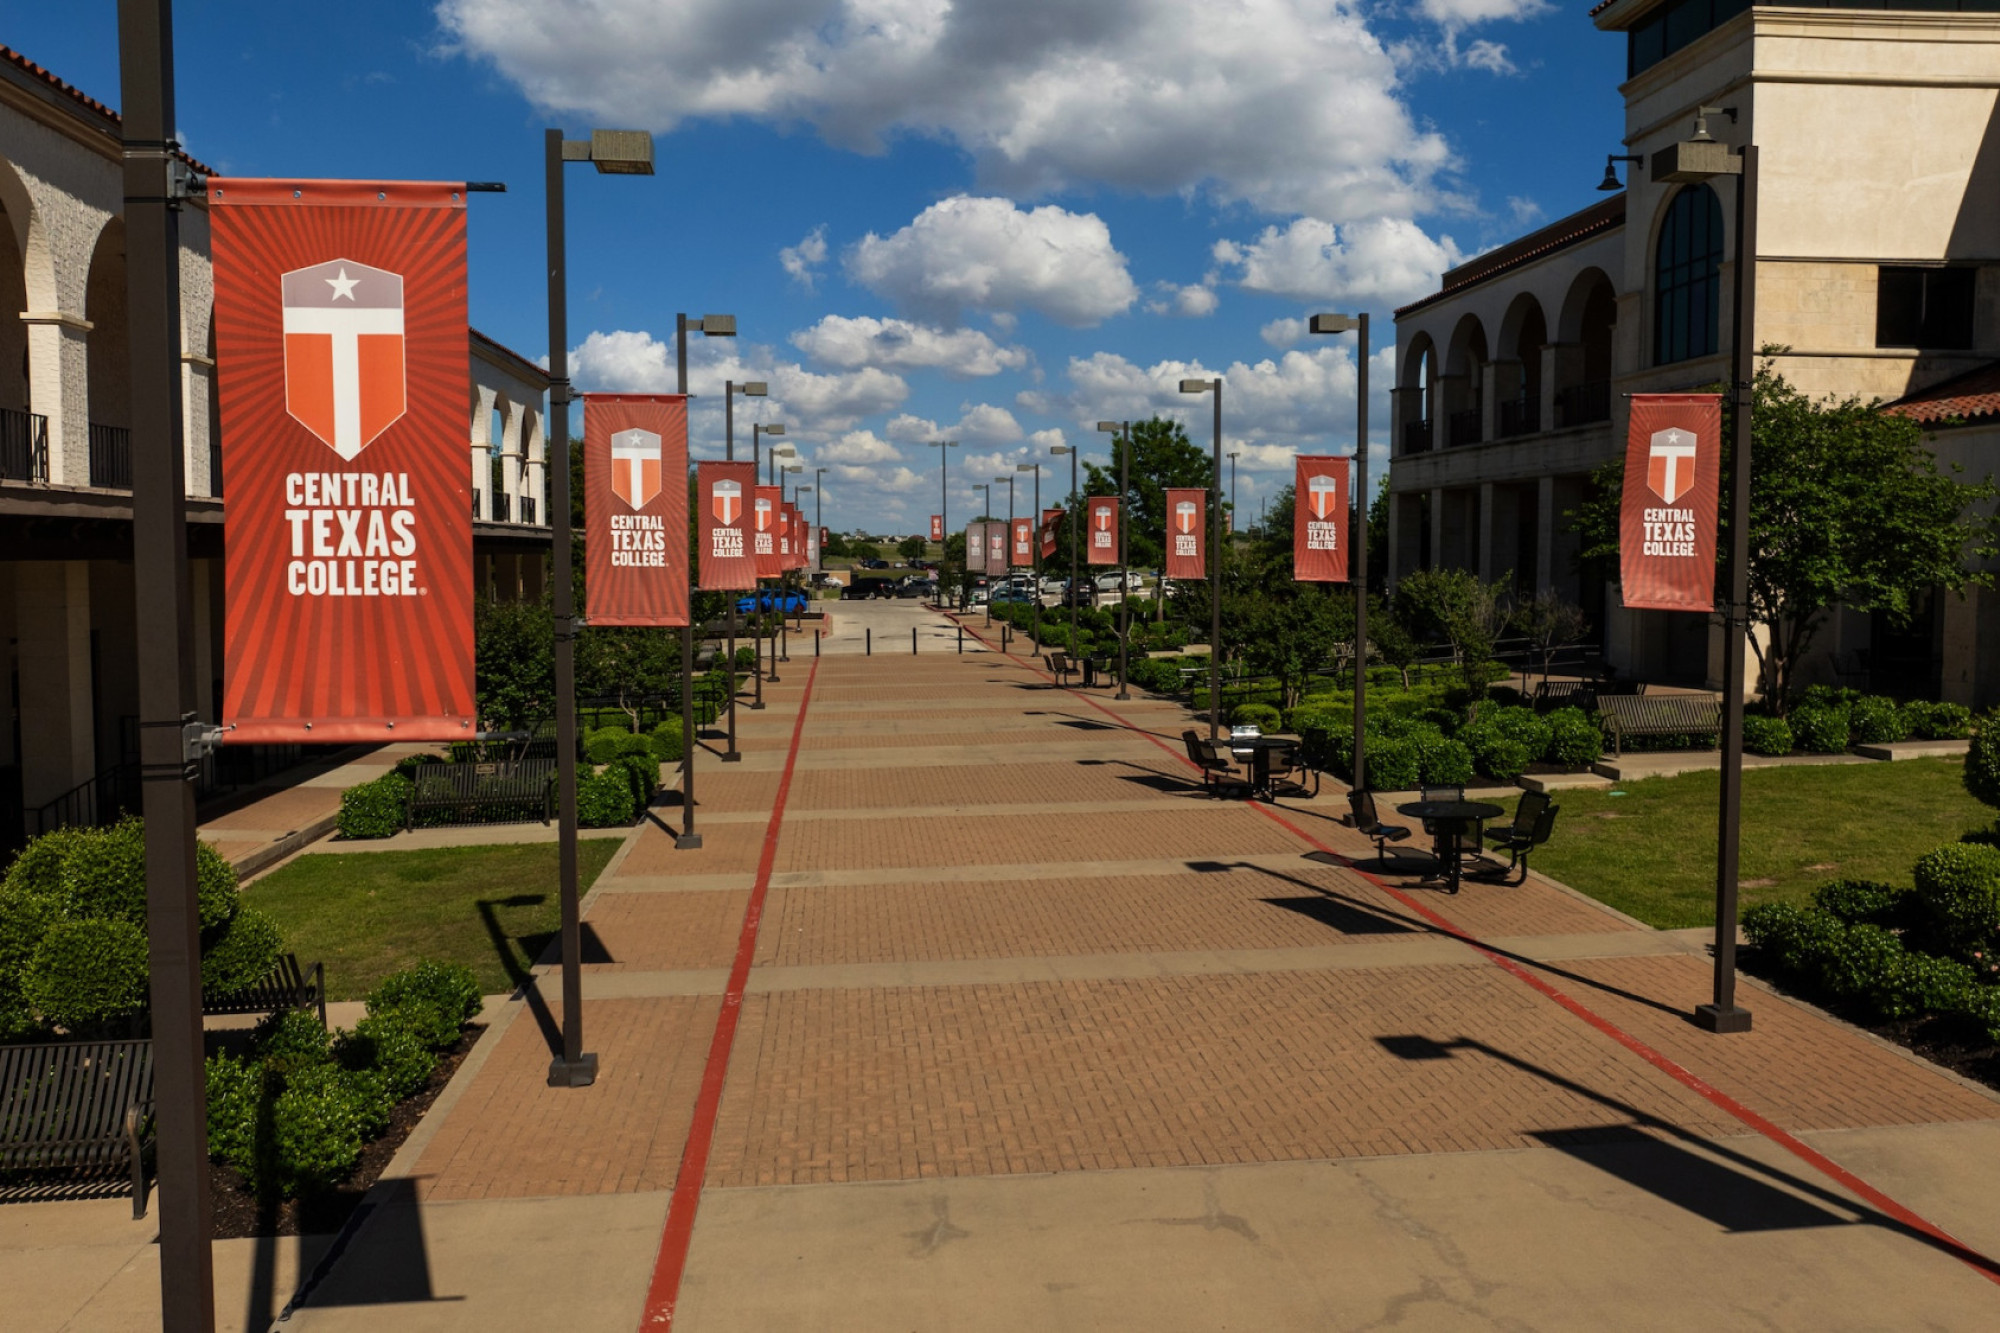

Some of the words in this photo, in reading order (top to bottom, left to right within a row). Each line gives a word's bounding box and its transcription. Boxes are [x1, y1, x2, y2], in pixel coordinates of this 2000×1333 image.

[286, 473, 415, 506] CENTRAL
[1643, 508, 1695, 522] CENTRAL
[611, 515, 664, 530] CENTRAL
[1308, 521, 1336, 530] CENTRAL
[285, 510, 417, 557] TEXAS
[712, 528, 742, 537] CENTRAL
[1307, 530, 1336, 540] TEXAS
[1643, 522, 1695, 541] TEXAS
[610, 530, 665, 550] TEXAS
[712, 537, 743, 548] TEXAS
[1176, 541, 1196, 549] TEXAS
[1307, 541, 1337, 550] COLLEGE
[712, 548, 743, 557] COLLEGE
[1643, 542, 1695, 556] COLLEGE
[611, 551, 666, 567] COLLEGE
